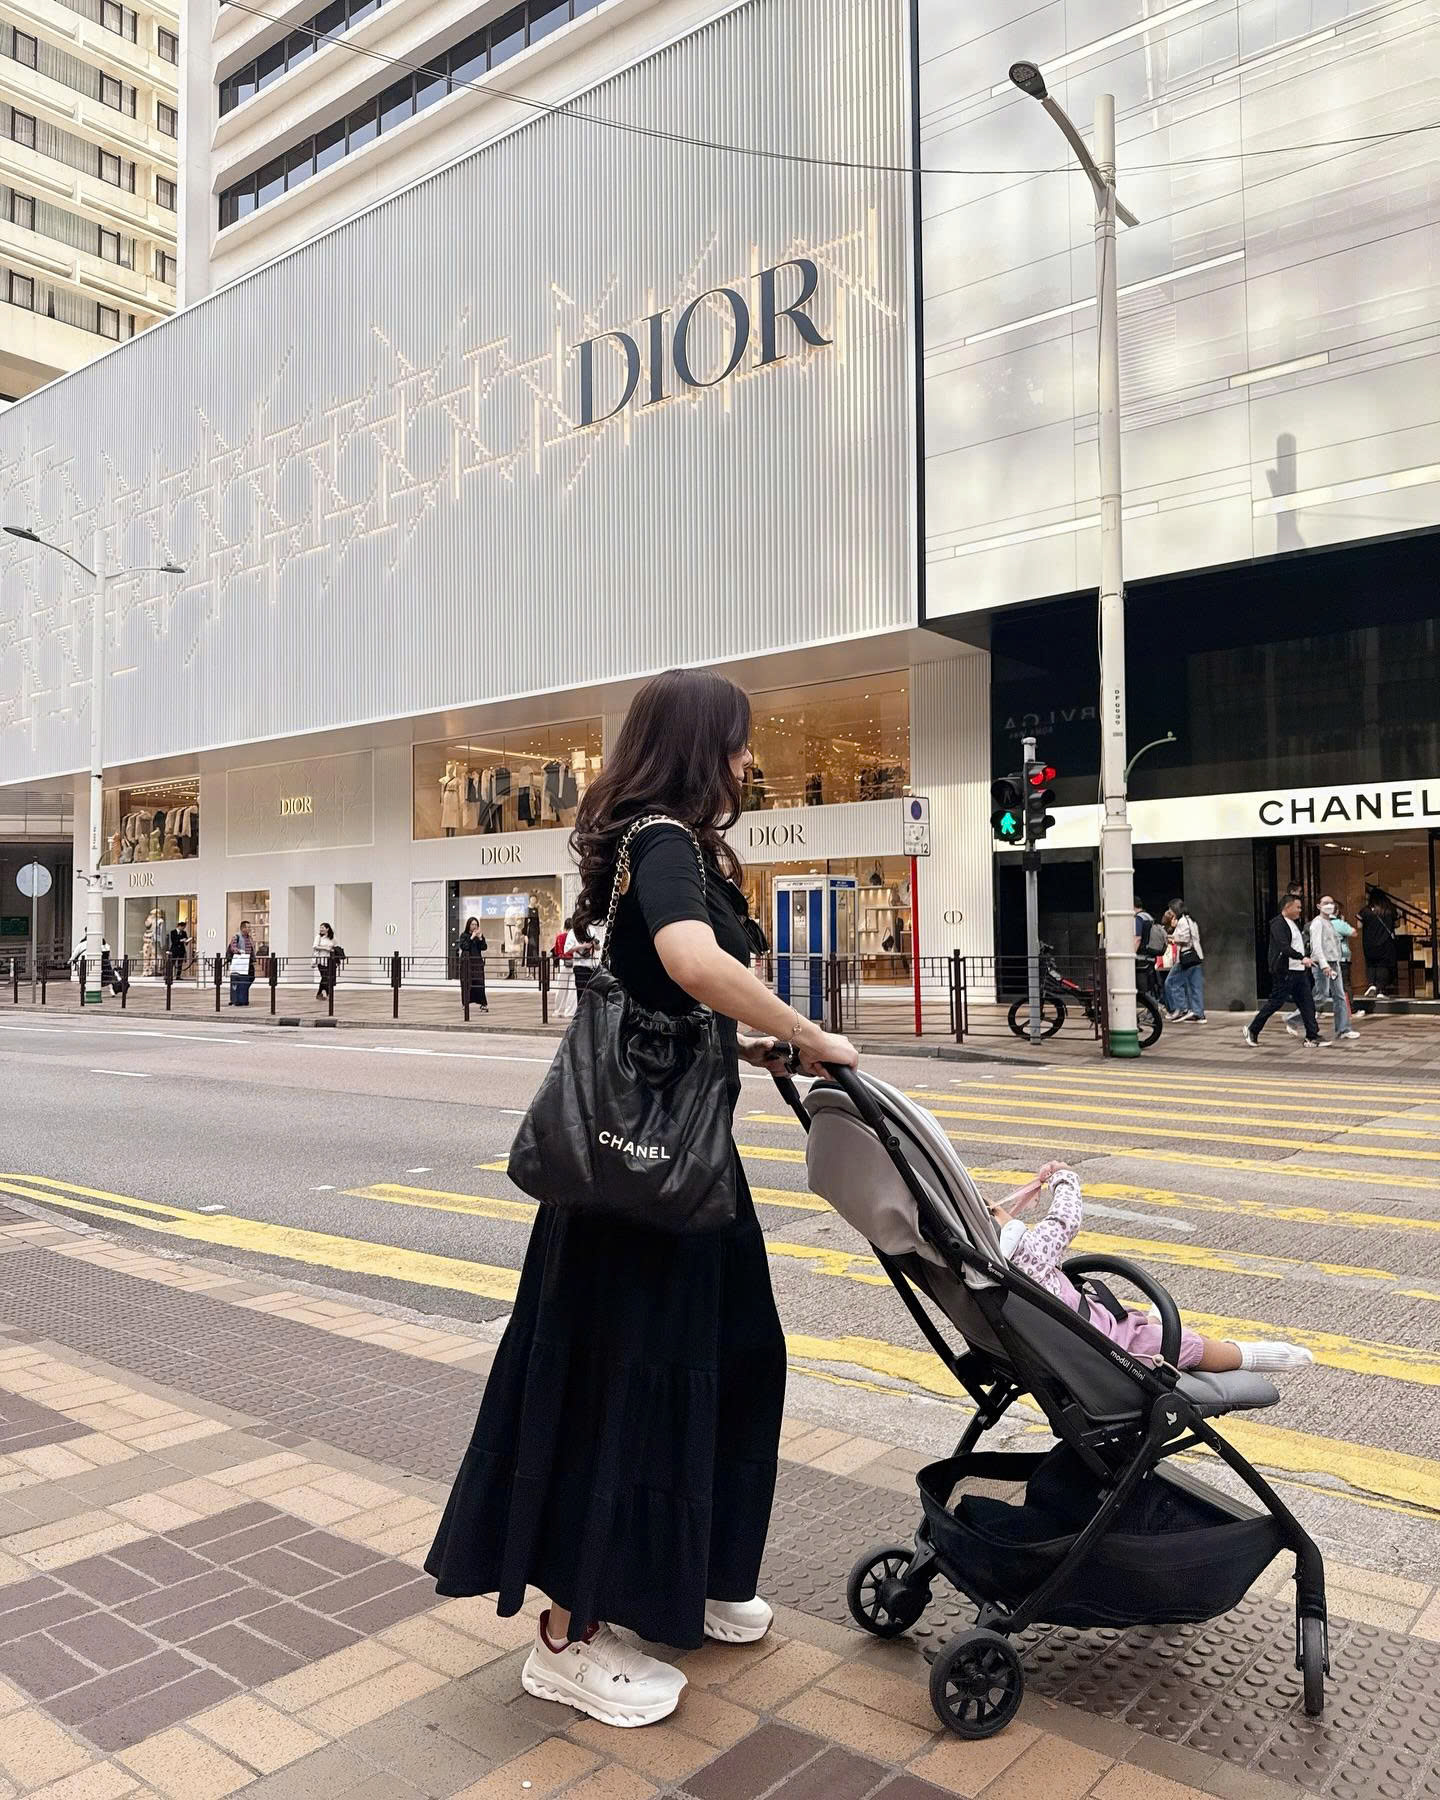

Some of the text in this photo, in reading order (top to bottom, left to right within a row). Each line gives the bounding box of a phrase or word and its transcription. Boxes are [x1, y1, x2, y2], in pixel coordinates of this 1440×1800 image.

[572, 258, 834, 431] DIOR
[280, 797, 312, 816] DIOR
[1259, 789, 1440, 826] CHANEL
[749, 823, 807, 847] DIOR
[481, 845, 522, 865] DIOR
[920, 843, 929, 854] 12
[129, 871, 155, 888] DIOR
[598, 1130, 671, 1160] CHANEL
